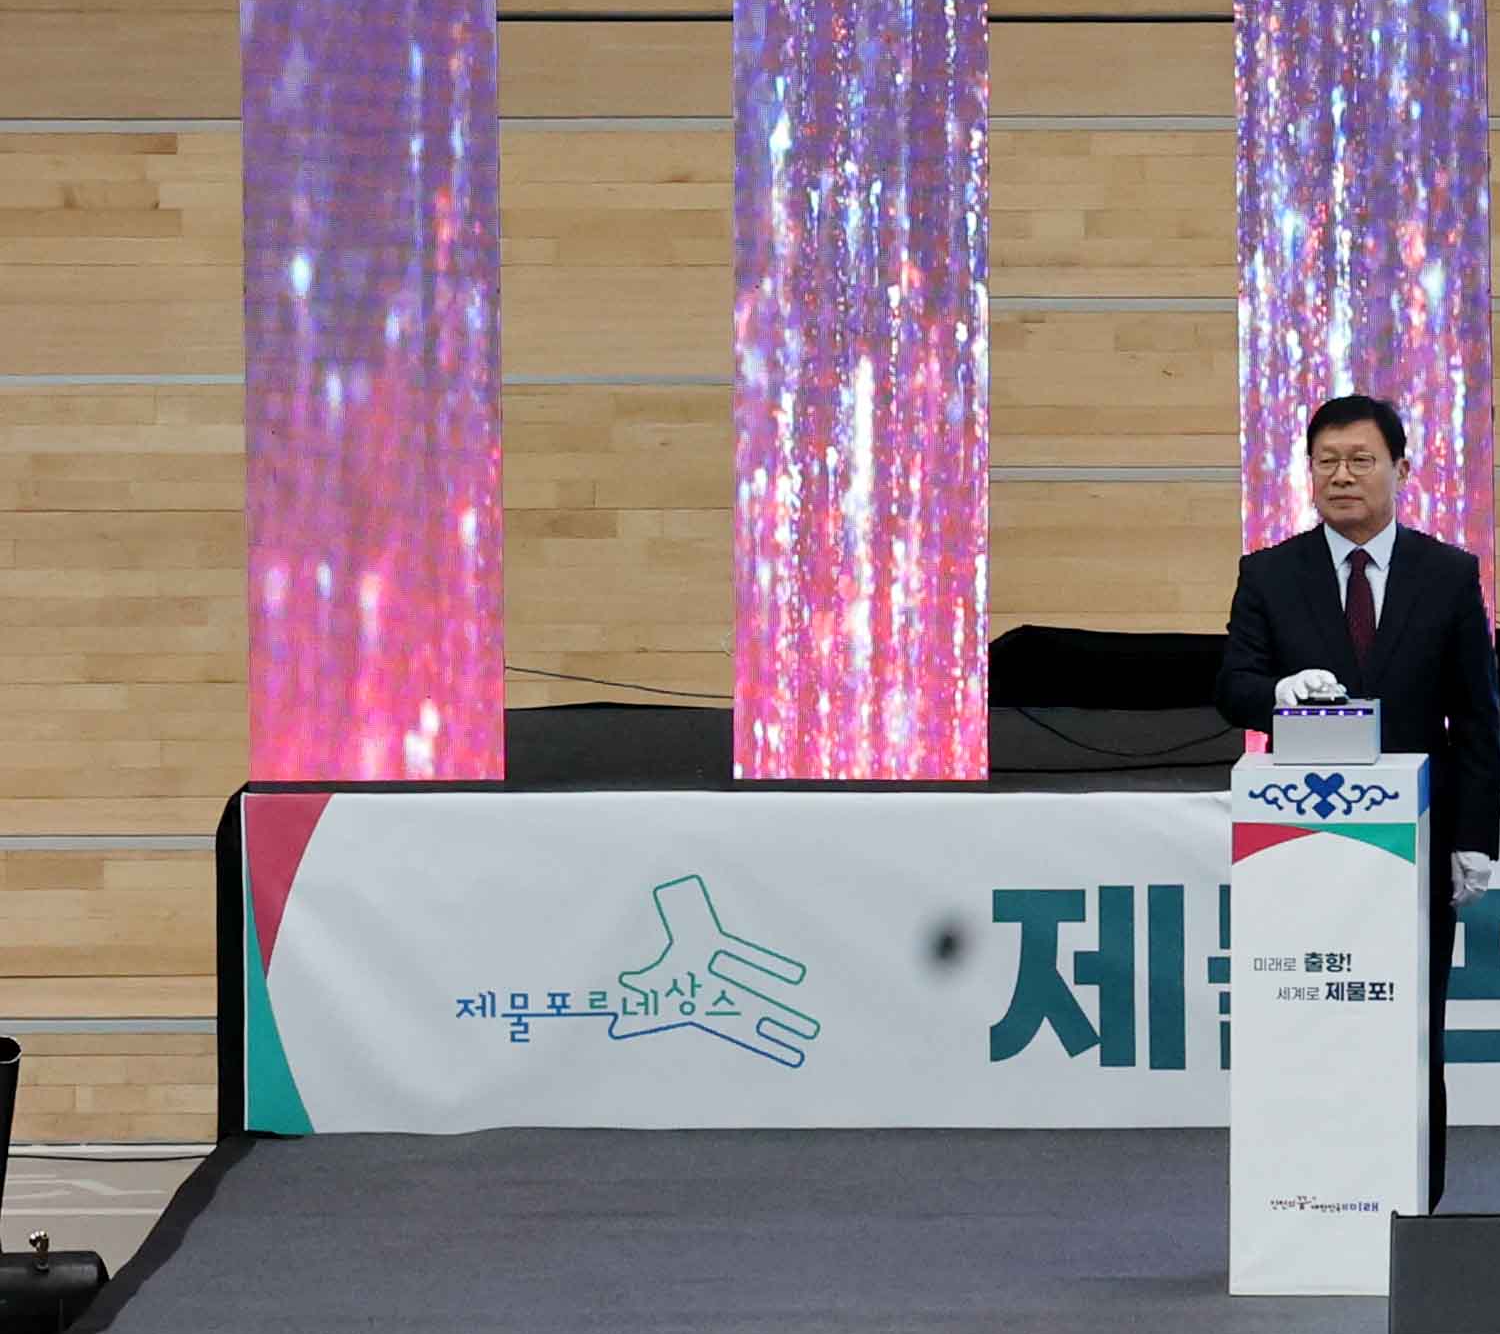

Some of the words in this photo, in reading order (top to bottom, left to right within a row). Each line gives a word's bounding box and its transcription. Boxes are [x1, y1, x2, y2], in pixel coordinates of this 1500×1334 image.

[1253, 957, 1296, 972] 미래로
[1304, 952, 1352, 972] 출항!
[1276, 987, 1319, 1001] 세계로
[1325, 981, 1394, 1001] 제물포!
[455, 970, 744, 1043] 제물포르네상스
